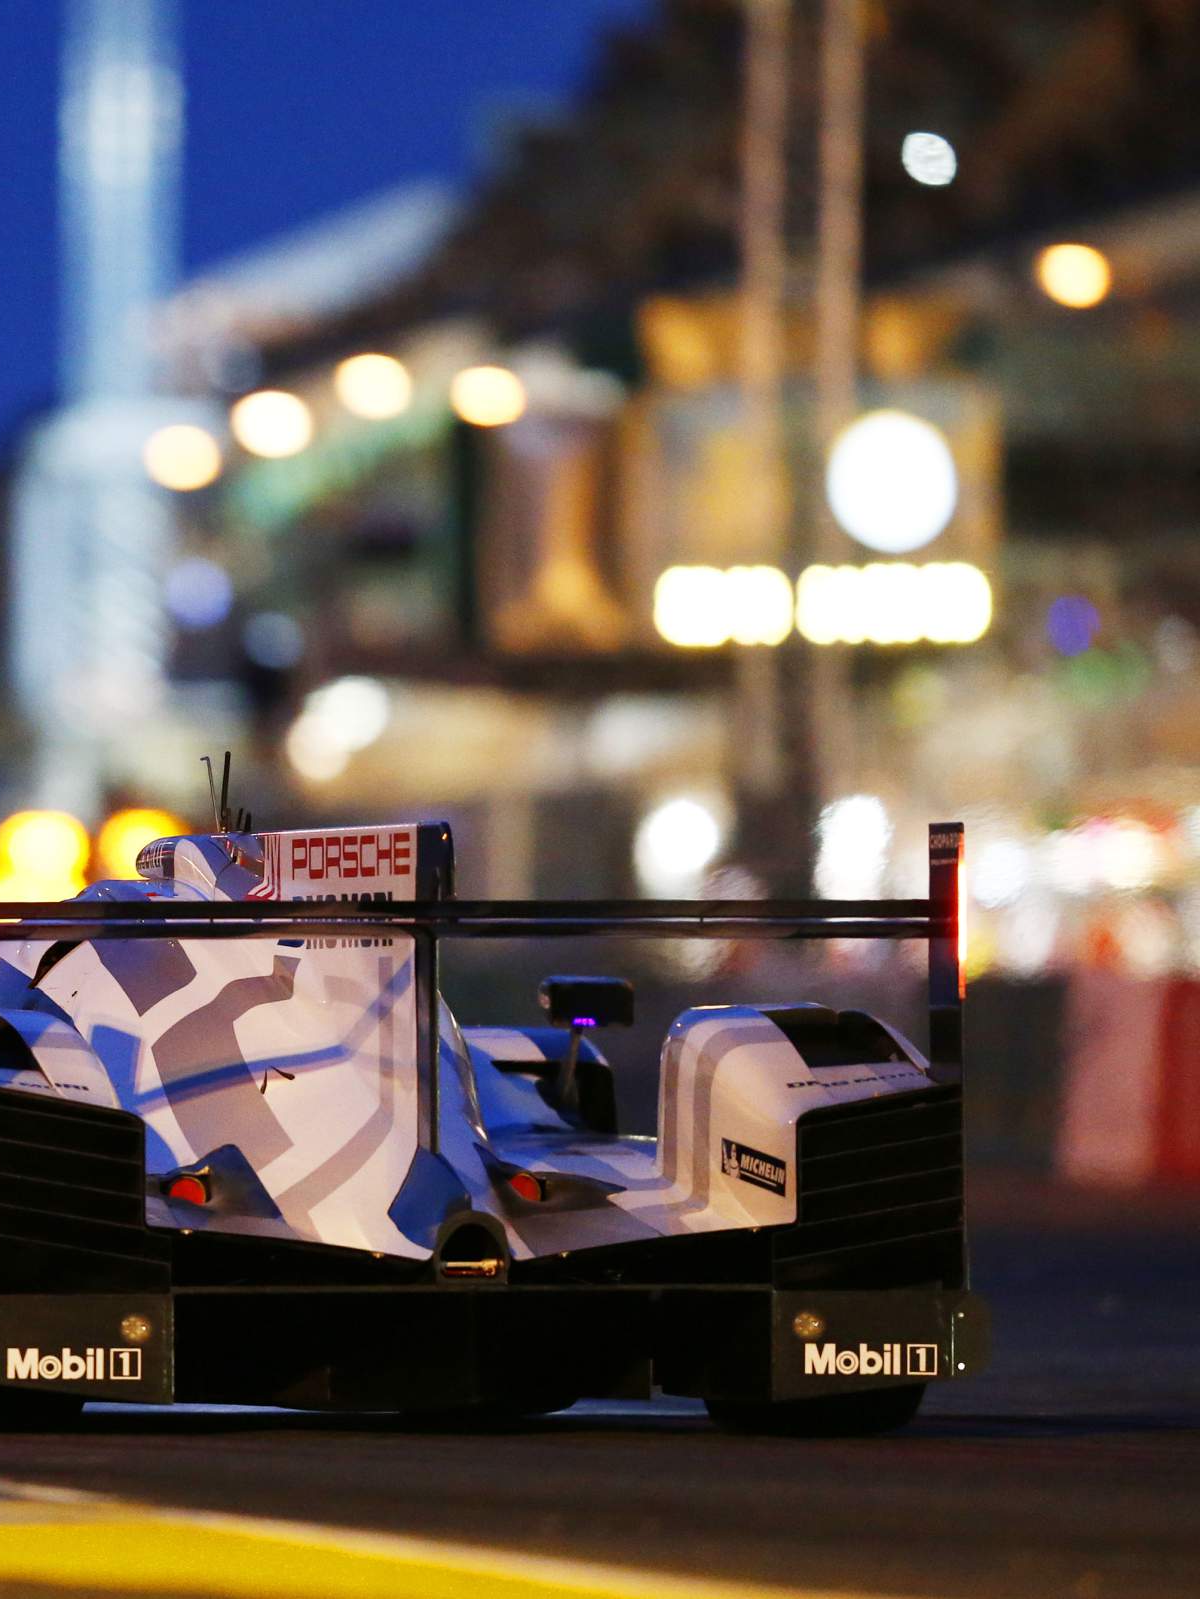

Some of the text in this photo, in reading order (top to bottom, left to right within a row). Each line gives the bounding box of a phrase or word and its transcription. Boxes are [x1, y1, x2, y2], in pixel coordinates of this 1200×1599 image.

[291, 832, 410, 881] PORSCHE
[740, 1153, 785, 1185] MICHELIN
[6, 1347, 134, 1380] Mobil 1
[804, 1343, 931, 1376] Mobil 1
